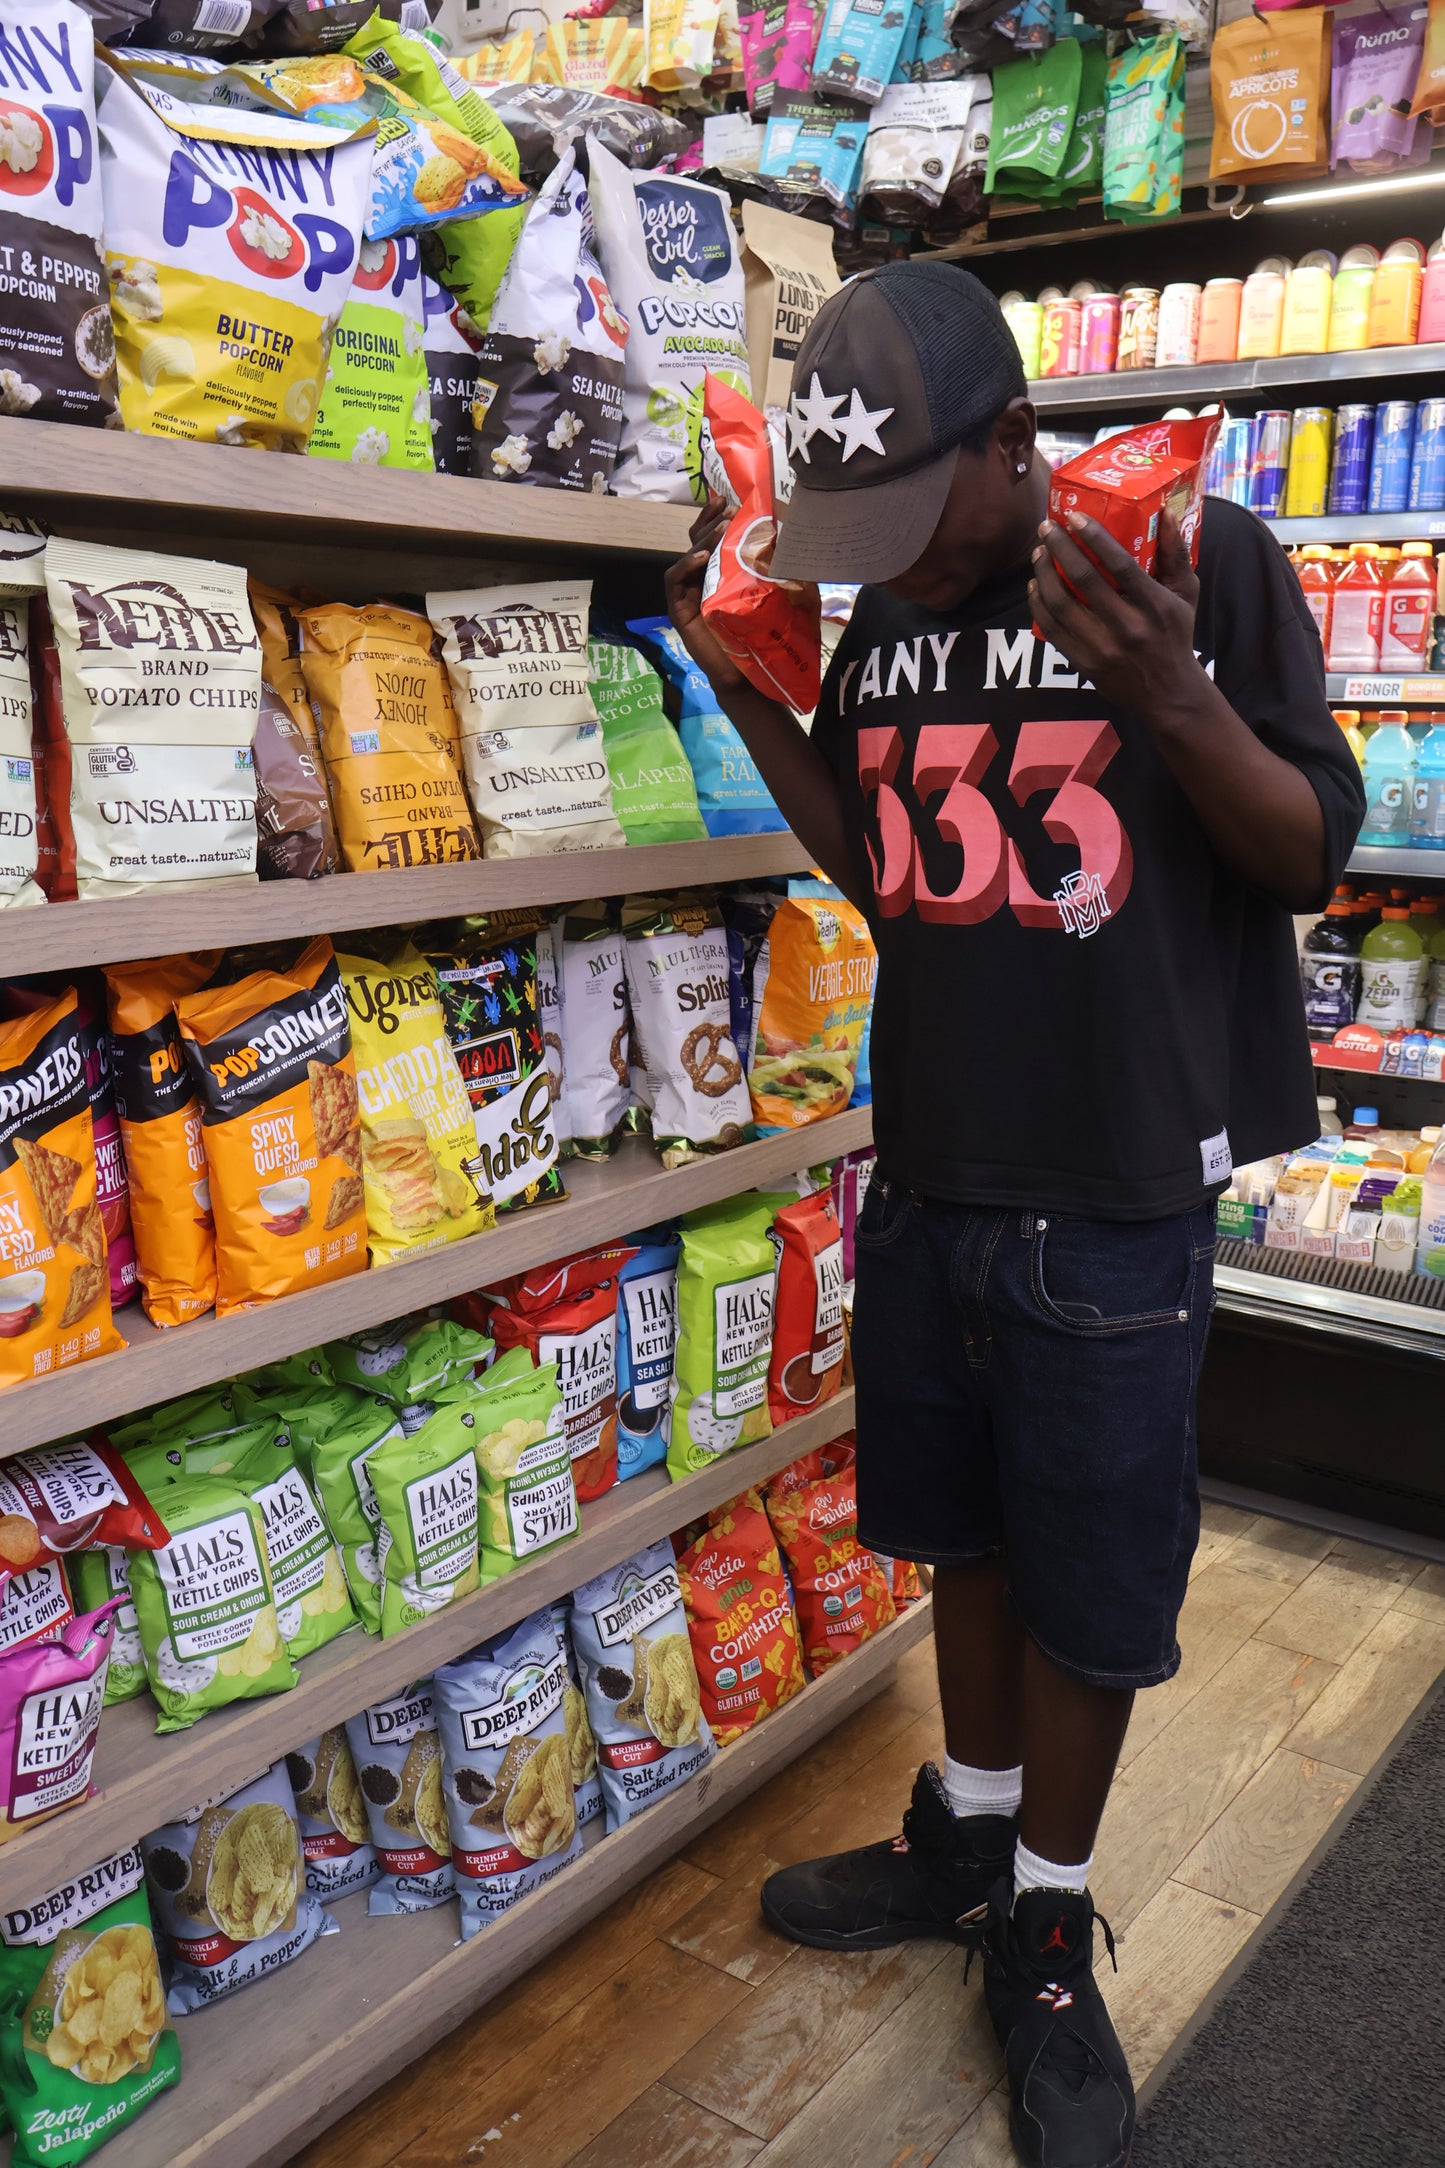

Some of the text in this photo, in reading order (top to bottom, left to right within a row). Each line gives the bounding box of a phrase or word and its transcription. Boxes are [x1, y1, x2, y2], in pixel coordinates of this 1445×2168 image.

[564, 57, 607, 71] Glazed
[564, 69, 608, 82] Pecans
[1229, 76, 1299, 99] APRICOTS
[1003, 105, 1068, 138] MANGOES
[163, 150, 355, 292] POP
[21, 250, 37, 277] &
[41, 255, 100, 296] PEPPER
[779, 281, 814, 311] LONG
[217, 313, 294, 356] BUTTER
[335, 328, 401, 358] ORIGINAL
[17, 342, 63, 357] seasoned
[219, 340, 284, 373] POPCORN
[346, 352, 395, 373] POPCORN
[236, 364, 265, 383] FLAVORED
[56, 387, 100, 402] no artificial
[206, 380, 278, 411] deliciously popped,
[335, 384, 405, 404] deliciously popped,
[572, 375, 593, 396] SEA
[594, 381, 617, 403] SALT
[203, 391, 276, 420] perfectly seasoned
[317, 410, 325, 424] 3
[342, 398, 400, 413] perfectly salted
[151, 421, 196, 440] real butter
[154, 411, 198, 430] made with
[59, 580, 262, 653] KETTLE
[1394, 598, 1407, 613] G
[141, 660, 209, 676] BRAND
[508, 660, 561, 674] BRAND
[857, 631, 961, 707] ANY
[86, 687, 258, 708] POTATO CHIPS
[375, 672, 426, 699] DIJON
[469, 682, 548, 703] POTATO
[599, 683, 643, 702] BRAND
[1363, 683, 1400, 696] GNGR
[374, 699, 427, 726] HONEY
[91, 753, 117, 764] GLUTEN
[92, 763, 108, 772] FREE
[489, 762, 605, 793] UNSALTED
[361, 783, 416, 804] CHIPS
[1380, 782, 1403, 807] G
[98, 799, 256, 825] UNSALTED
[408, 806, 453, 822] BRAND
[857, 720, 1134, 928] 333
[109, 853, 146, 867] great
[809, 959, 845, 1004] VEGGIE
[1315, 966, 1342, 992] G
[677, 974, 730, 1013] Splits
[824, 1009, 843, 1032] Sea
[1335, 1040, 1379, 1053] BOTTLES
[221, 1047, 317, 1102] THE CRUNCHY AND WHOLESOME
[482, 1072, 515, 1086] New Orleans
[409, 1091, 441, 1122] SOUR
[251, 1114, 295, 1151] SPICY
[253, 1141, 300, 1176] QUESO
[284, 1157, 318, 1177] FLAVORED
[1210, 1156, 1227, 1169] EST.
[14, 1245, 55, 1272] FLAVORED
[304, 1247, 320, 1260] NEVER
[326, 1240, 340, 1254] 140
[305, 1256, 321, 1270] FRIED
[726, 1287, 771, 1330] HAL'S
[60, 1338, 79, 1354] 140
[555, 1332, 613, 1380] HAL'S
[637, 1366, 656, 1381] SEA
[564, 1409, 602, 1437] BARBEQUE
[56, 1447, 115, 1498] HAL'S
[8, 1465, 43, 1508] BARBEQUE
[419, 1468, 473, 1517] HAL'S
[282, 1507, 306, 1528] YORK
[422, 1492, 475, 1527] NEW YORK
[809, 1496, 857, 1531] Garcia
[523, 1504, 572, 1544] HAL'S
[167, 1529, 244, 1577] HAL'S
[276, 1534, 330, 1575] CREAM & ONION
[418, 1535, 469, 1568] SOUR CREAM &
[177, 1557, 245, 1588] NEW YORK
[25, 1587, 52, 1608] YORK
[172, 1568, 259, 1609] KETTLE CHIPS
[634, 1574, 681, 1614] RIVER
[172, 1591, 266, 1632] SOUR CREAM & ONION
[717, 1687, 761, 1712] GLUTEN FREE
[375, 1698, 434, 1736] DEEP
[472, 1702, 527, 1740] DEEP
[35, 1727, 72, 1742] NEW
[610, 1742, 653, 1757] KRINKLE
[622, 1751, 642, 1763] CUT
[622, 1761, 665, 1788] Salt &
[624, 1771, 676, 1803] Cracked
[304, 1844, 326, 1856] CUT
[385, 1851, 427, 1863] KRINKLE
[465, 1850, 510, 1864] KRINKLE
[305, 1862, 365, 1894] Cracked
[396, 1860, 417, 1871] CUT
[477, 1861, 499, 1873] CUT
[477, 1876, 536, 1912] Cracked
[4, 1885, 76, 1938] DEEP
[176, 1940, 220, 1953] KRINKLE
[188, 1950, 209, 1962] CUT
[27, 2101, 92, 2135] Zesty
[38, 2099, 128, 2154] Jalapeño
